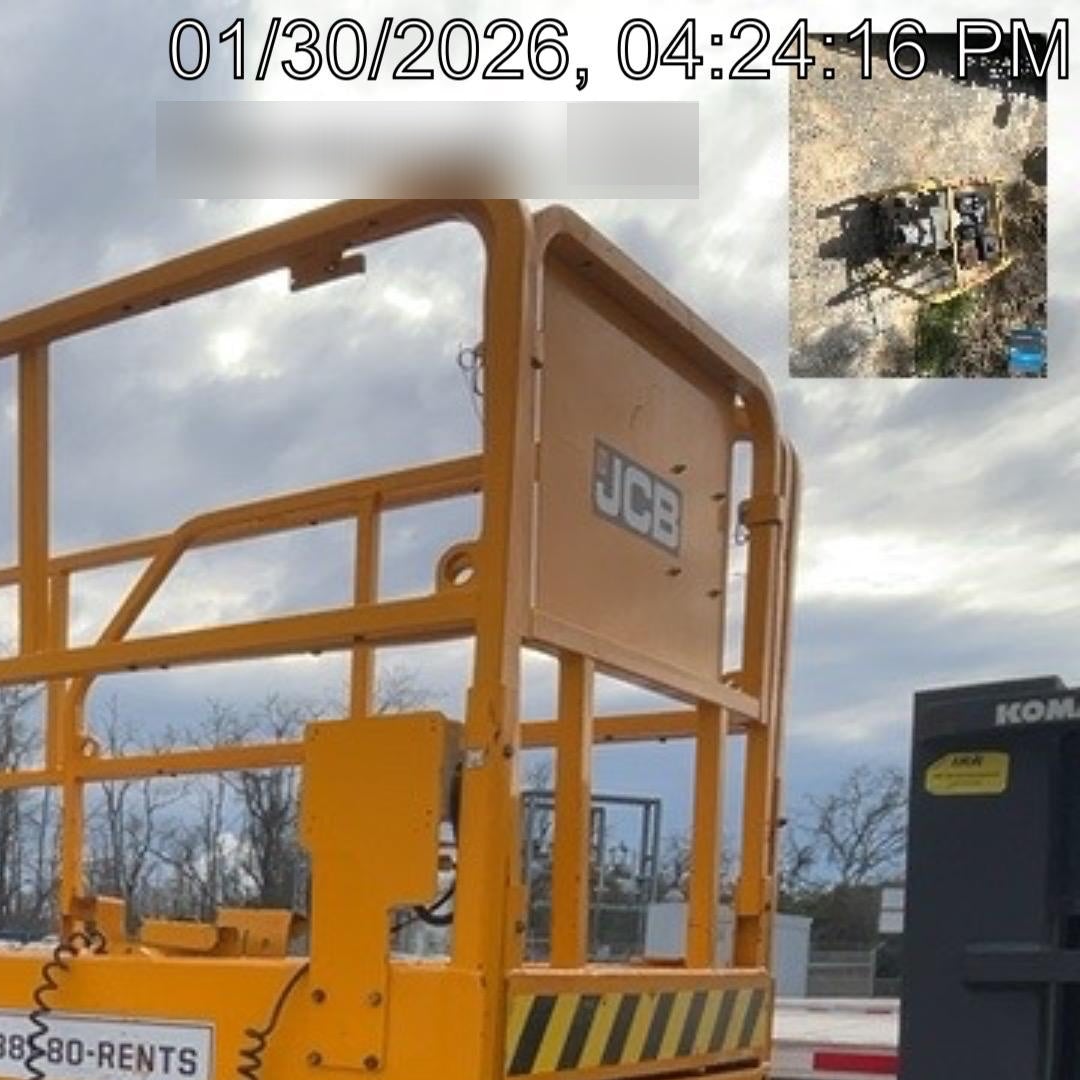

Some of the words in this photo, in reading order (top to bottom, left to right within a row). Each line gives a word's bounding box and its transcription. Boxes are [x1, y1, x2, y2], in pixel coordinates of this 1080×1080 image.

[595, 457, 681, 548] JCB
[994, 697, 1080, 727] KOM
[46, 1037, 198, 1077] 80-RENTS
